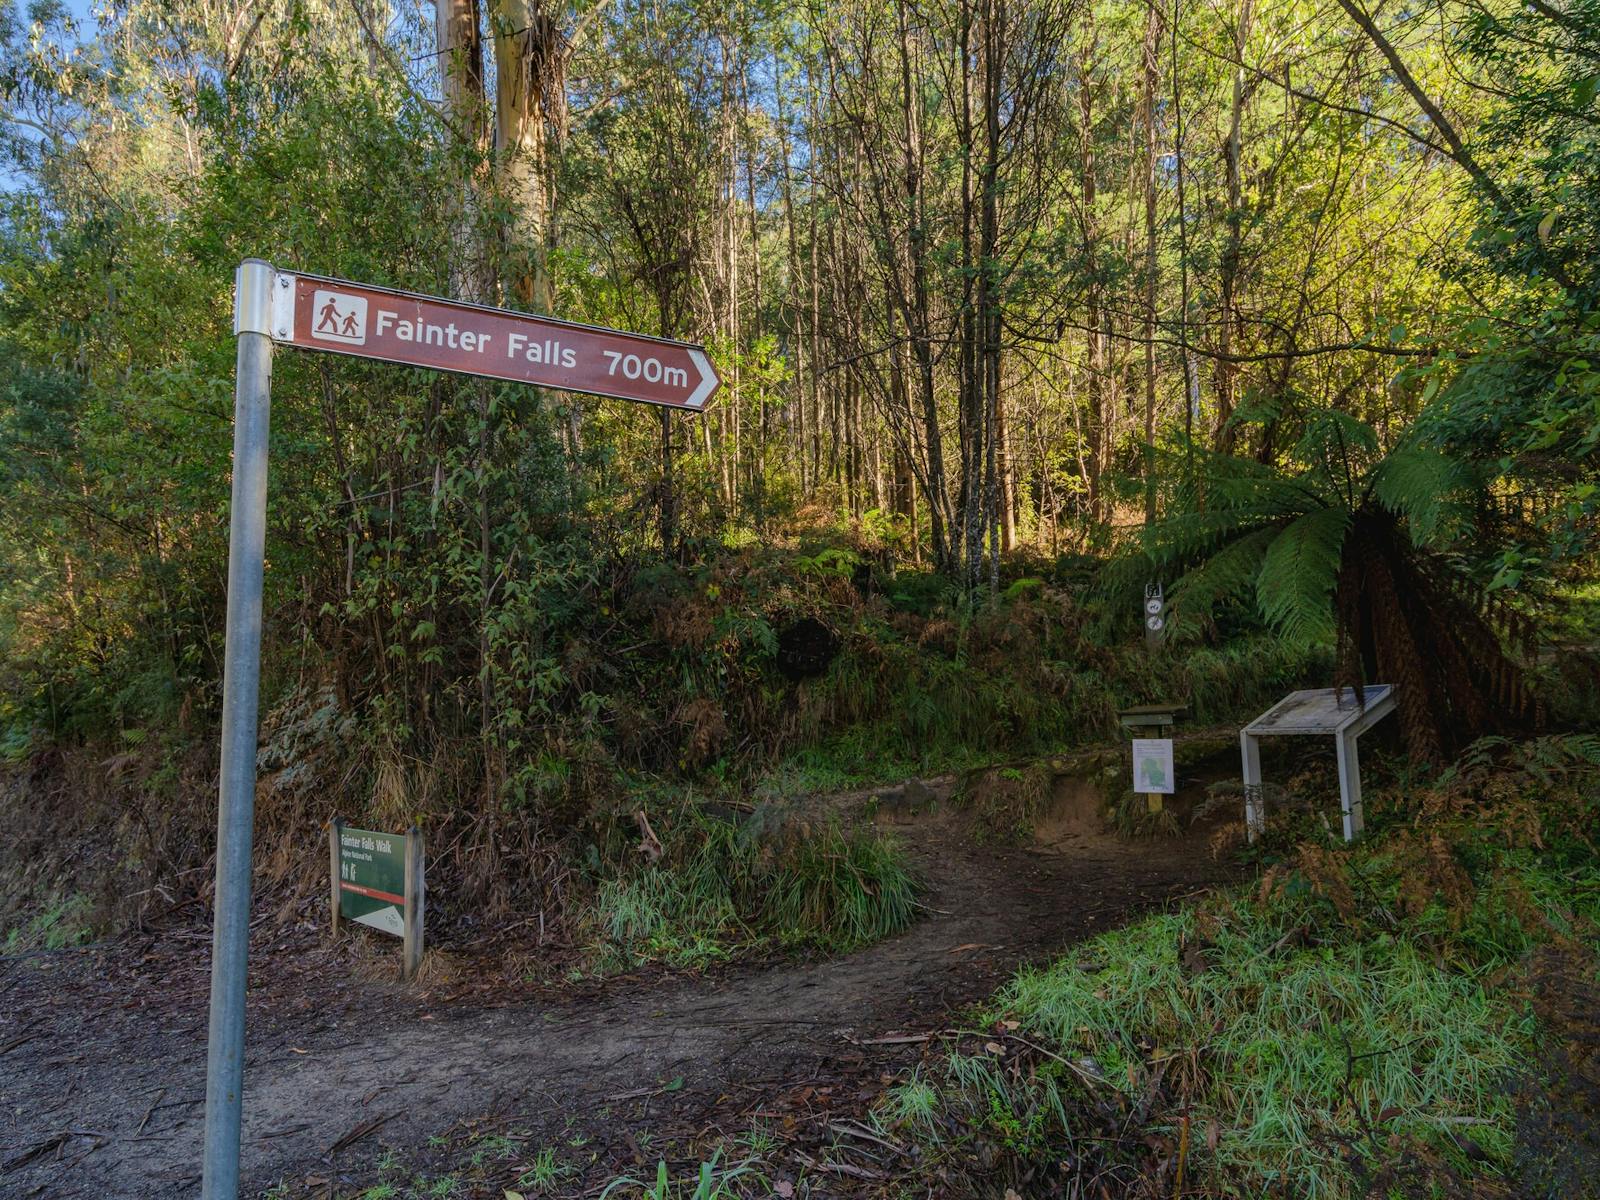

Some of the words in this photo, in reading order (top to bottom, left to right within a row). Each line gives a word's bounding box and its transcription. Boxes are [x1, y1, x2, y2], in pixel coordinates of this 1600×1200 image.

[376, 310, 491, 352] Fainter
[508, 333, 577, 368] Falls
[603, 350, 688, 388] 700m
[341, 834, 360, 848] Fainter
[361, 837, 375, 851] Falls
[375, 839, 392, 854] Walk
